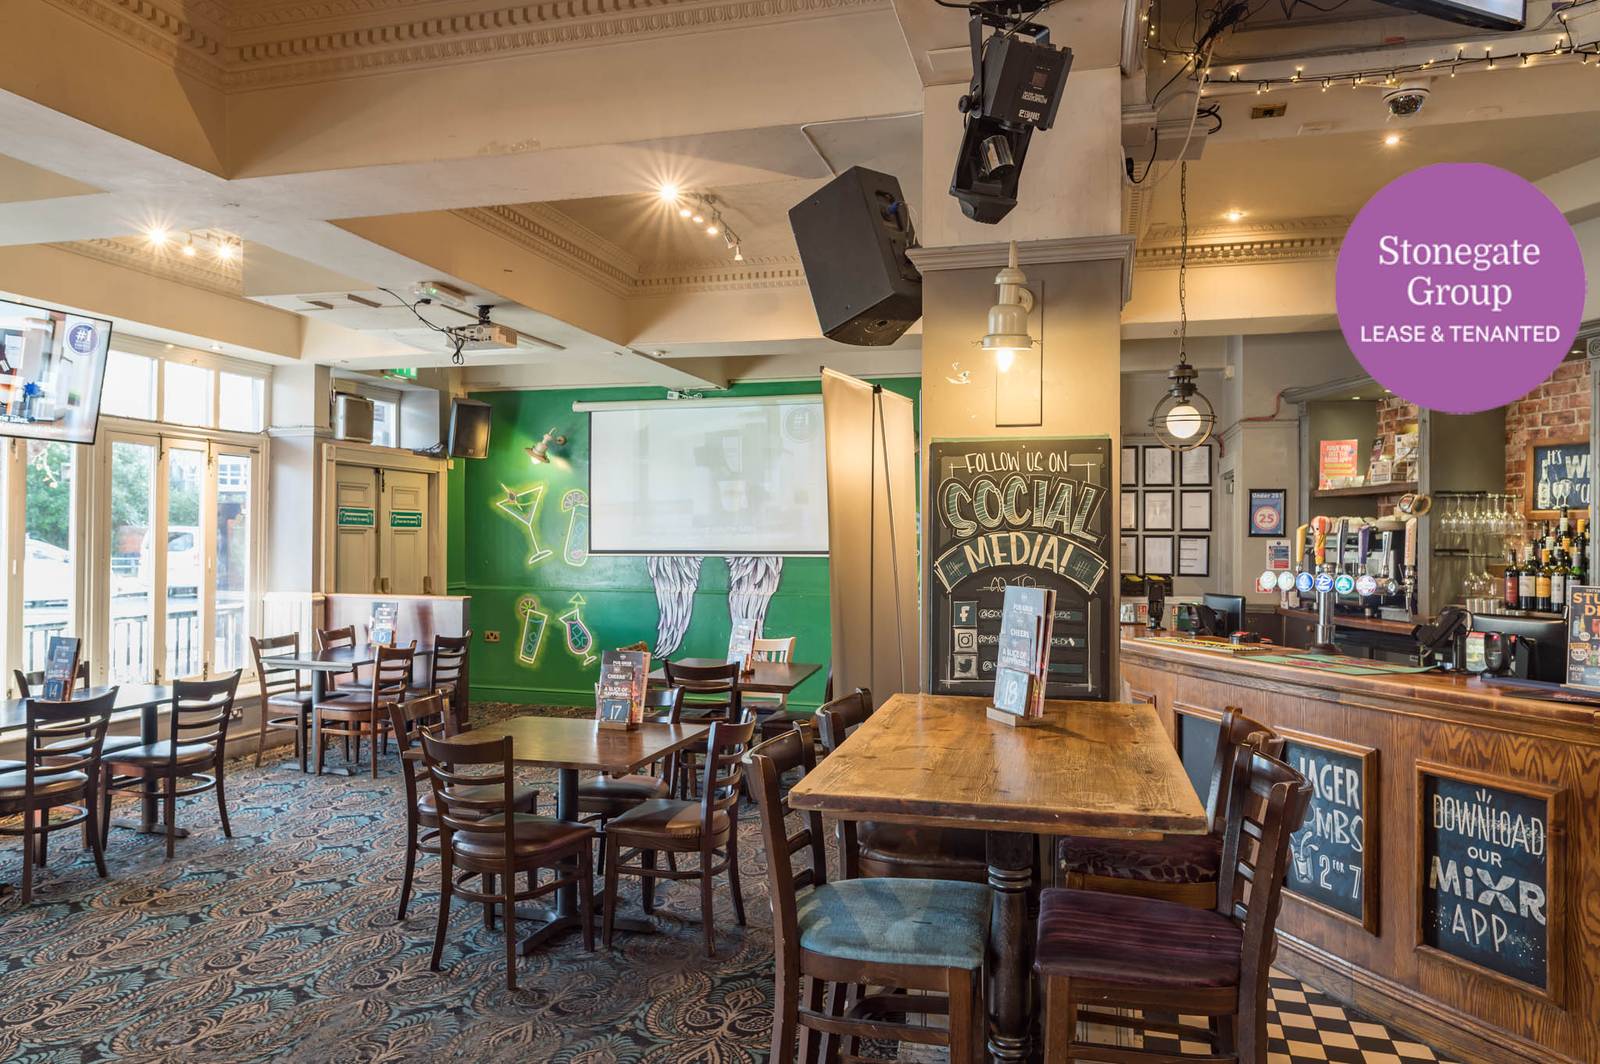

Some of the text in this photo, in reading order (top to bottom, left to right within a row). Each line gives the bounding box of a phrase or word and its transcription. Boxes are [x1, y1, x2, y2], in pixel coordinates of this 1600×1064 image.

[965, 450, 1068, 474] FOLLOW US ON
[943, 474, 1099, 544] SOCIAL
[1258, 513, 1274, 524] 25
[963, 531, 1075, 574] MEDIA!
[1004, 680, 1018, 705] 18
[610, 704, 622, 720] 17
[1433, 793, 1545, 856] DOWNLOAD
[1467, 846, 1502, 868] OUR
[1319, 854, 1362, 899] 2 FOR 7
[1452, 903, 1508, 952] APP
